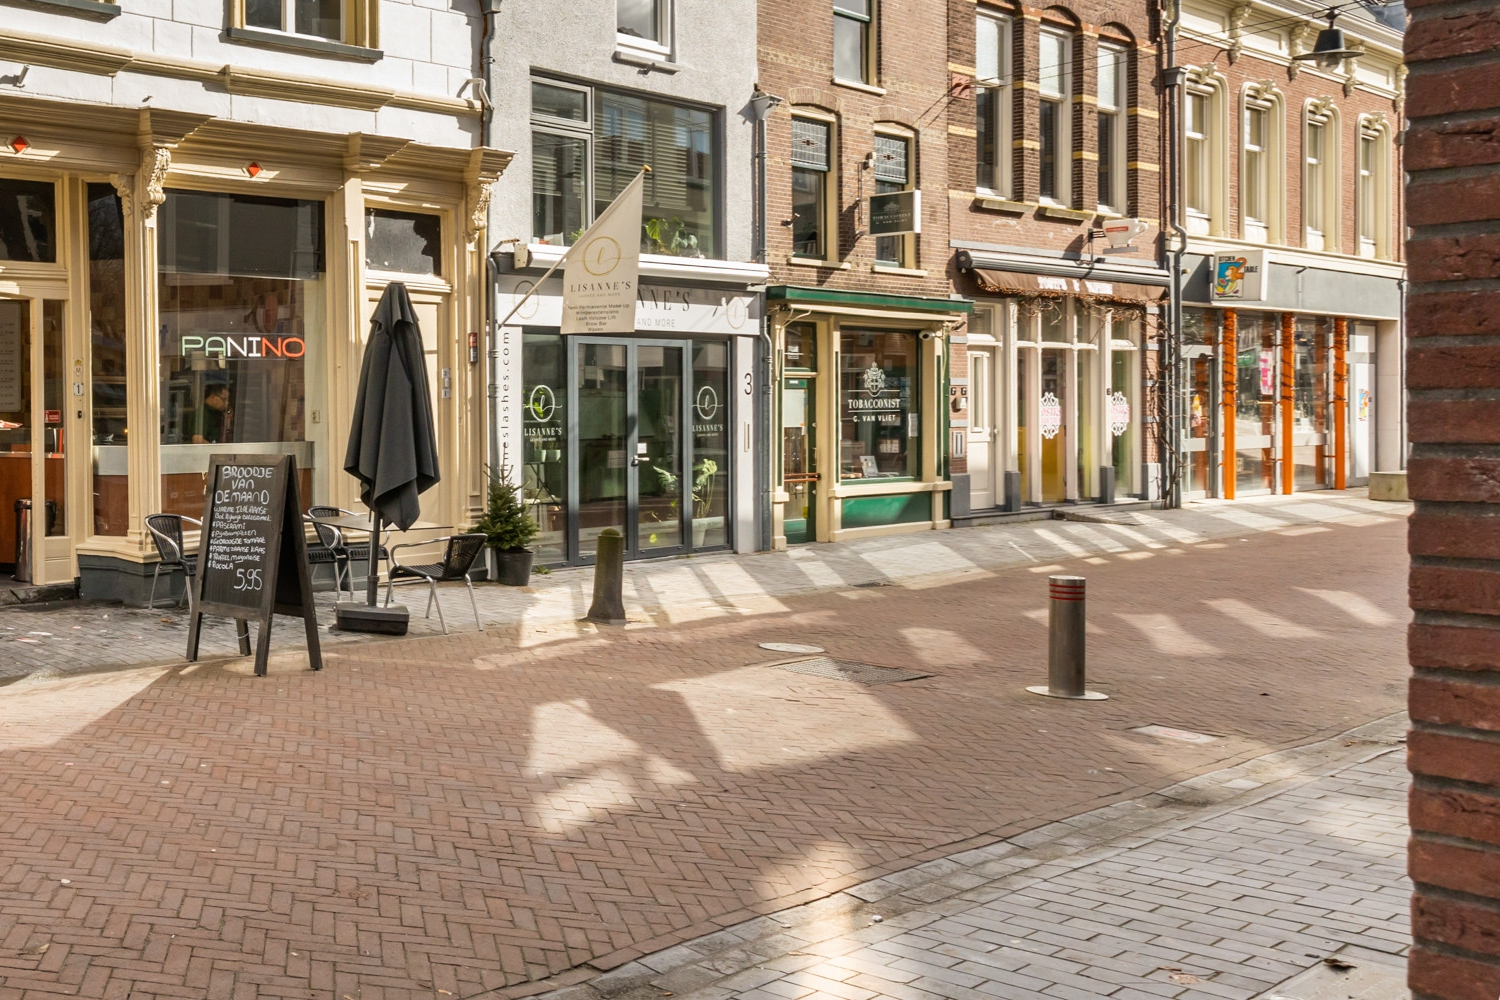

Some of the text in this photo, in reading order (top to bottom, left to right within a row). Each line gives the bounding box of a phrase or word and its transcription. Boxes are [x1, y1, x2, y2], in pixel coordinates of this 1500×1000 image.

[570, 281, 632, 293] LISANNE'S
[638, 289, 691, 312] NNE'S
[637, 318, 676, 328] AND MORE
[181, 336, 306, 358] PANINO
[744, 372, 753, 396] 3
[847, 399, 901, 409] TOBACCONIST
[877, 414, 897, 422] VLIET
[524, 427, 563, 437] LISANNE'S
[692, 424, 724, 432] LISANNE'S
[222, 465, 274, 479] BROODJE
[231, 478, 255, 490] VAN
[233, 568, 263, 592] 5,95
